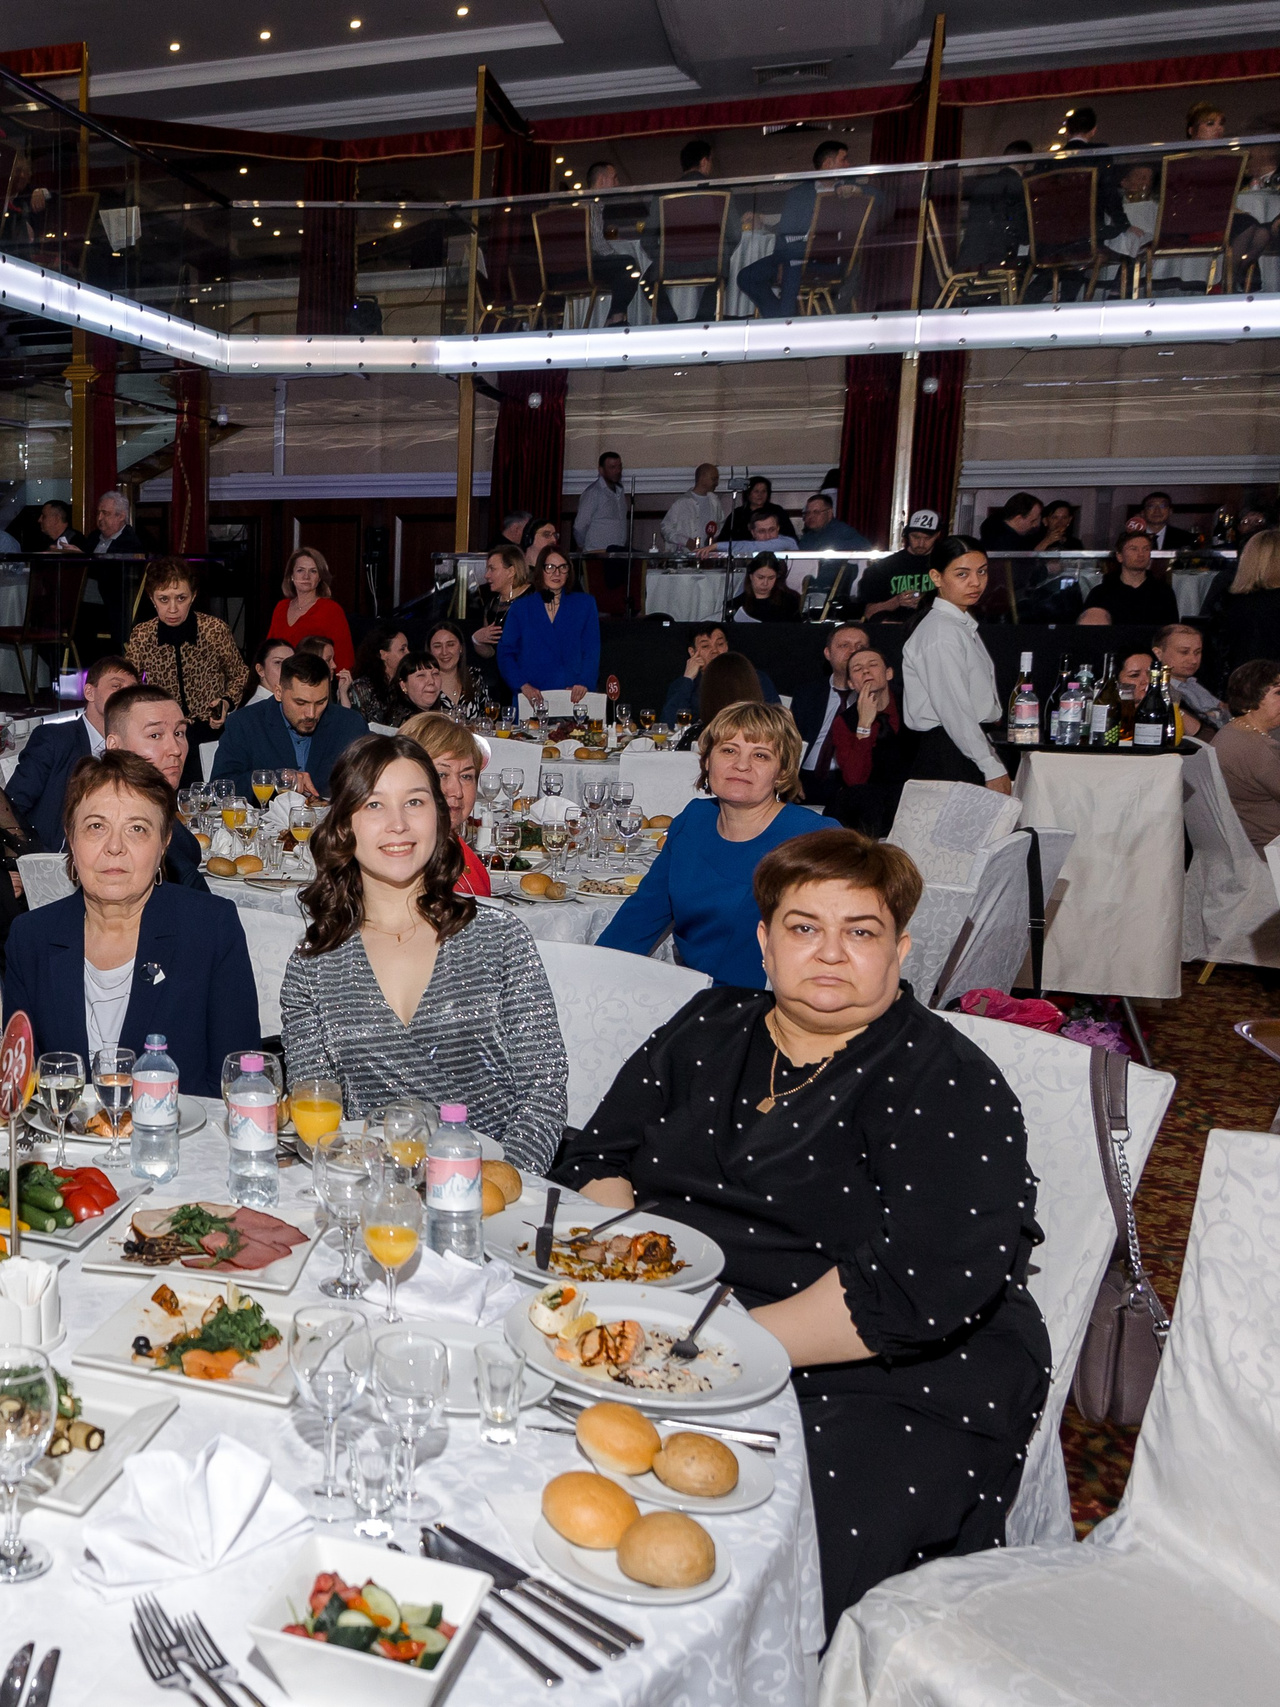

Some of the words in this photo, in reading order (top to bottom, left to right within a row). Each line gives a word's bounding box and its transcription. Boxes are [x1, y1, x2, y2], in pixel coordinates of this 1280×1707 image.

[913, 514, 935, 529] #24
[890, 574, 921, 595] STAGE
[608, 682, 619, 694] 35
[2, 1036, 27, 1091] 23
